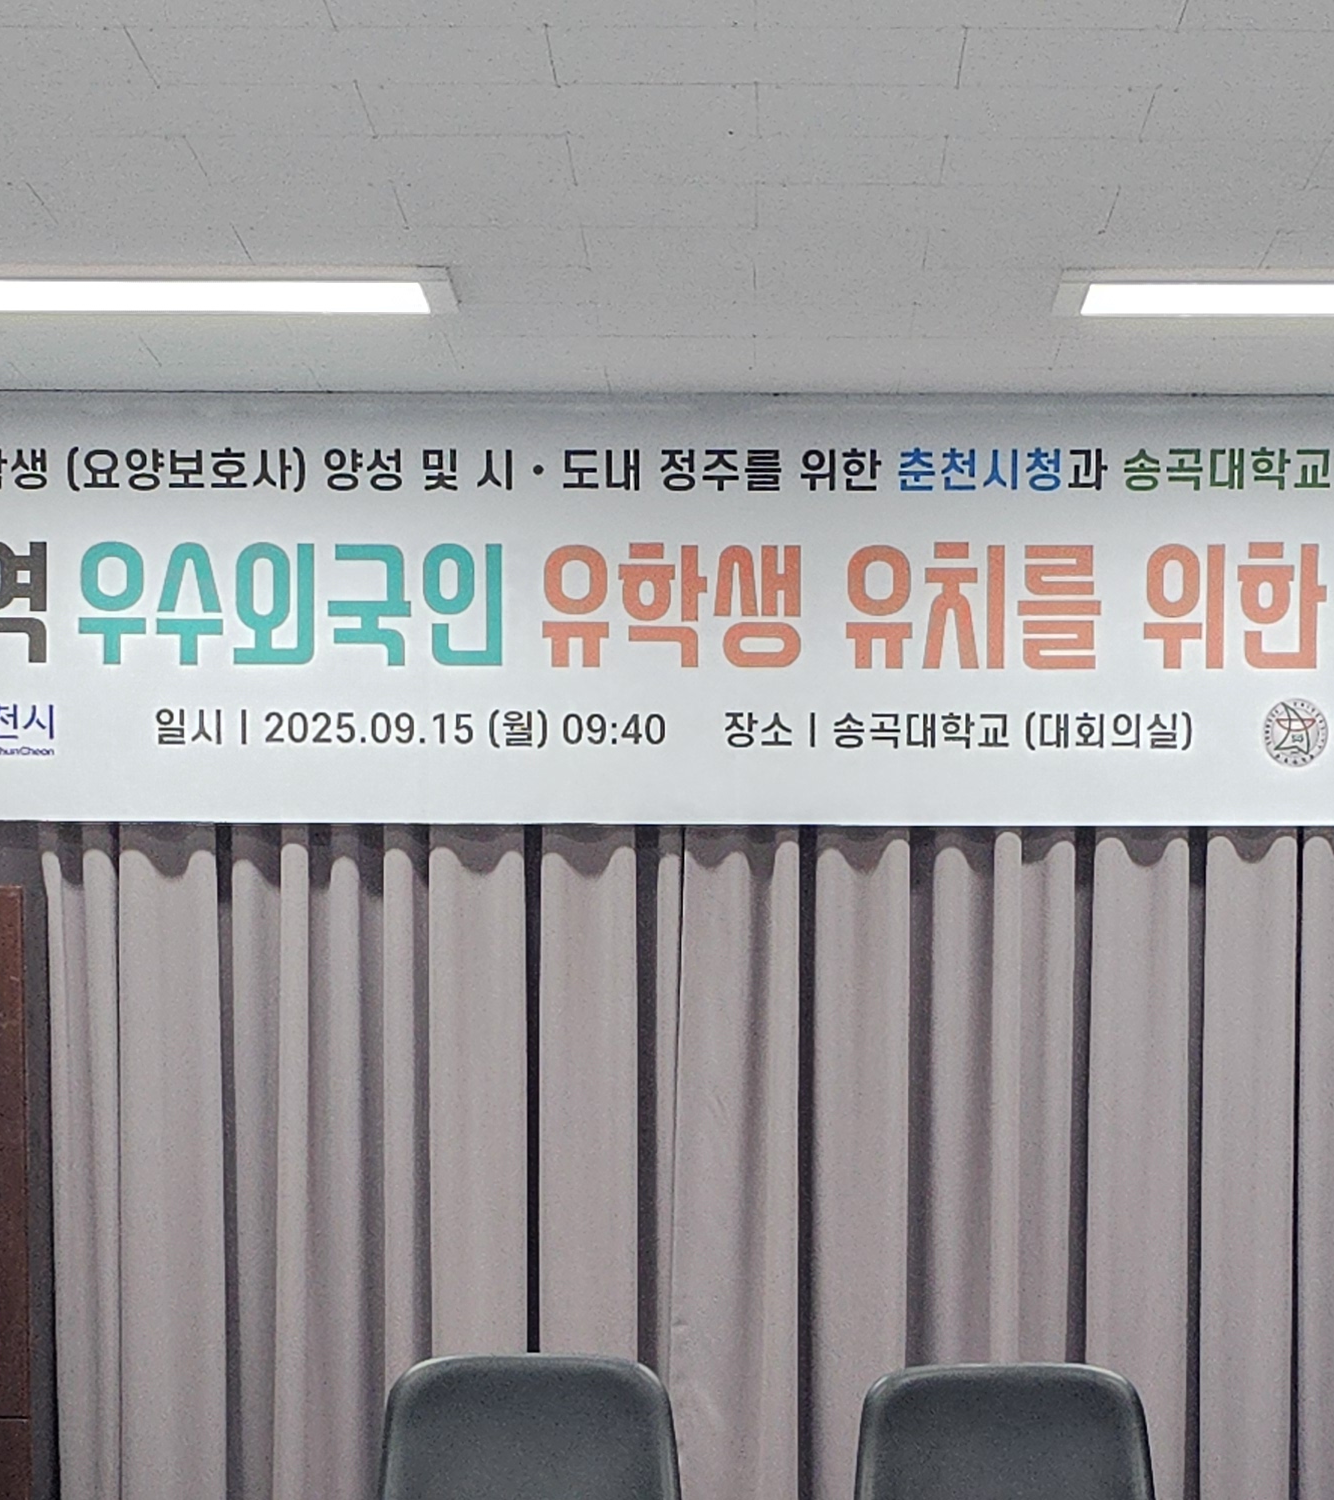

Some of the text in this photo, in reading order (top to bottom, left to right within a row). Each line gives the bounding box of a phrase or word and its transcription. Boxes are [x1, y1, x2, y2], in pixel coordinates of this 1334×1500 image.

[67, 446, 306, 493] (요양보호사)
[324, 447, 403, 492] 양성
[422, 447, 459, 492] 및
[659, 447, 783, 492] 정주를
[800, 447, 883, 492] 위한
[897, 446, 1109, 492] 춘천시청과
[78, 541, 503, 667] 우수외국인
[542, 542, 802, 668] 유학생
[845, 541, 1101, 670] 유치를
[1143, 541, 1327, 669] 위한
[155, 708, 222, 745] 일시
[264, 710, 474, 745] 2025.09.15
[488, 708, 548, 750] (월)
[562, 711, 666, 745] 09:40
[724, 711, 793, 749] 장소
[833, 711, 1010, 750] 송곡대학교
[1025, 710, 1193, 751] (대회의실)
